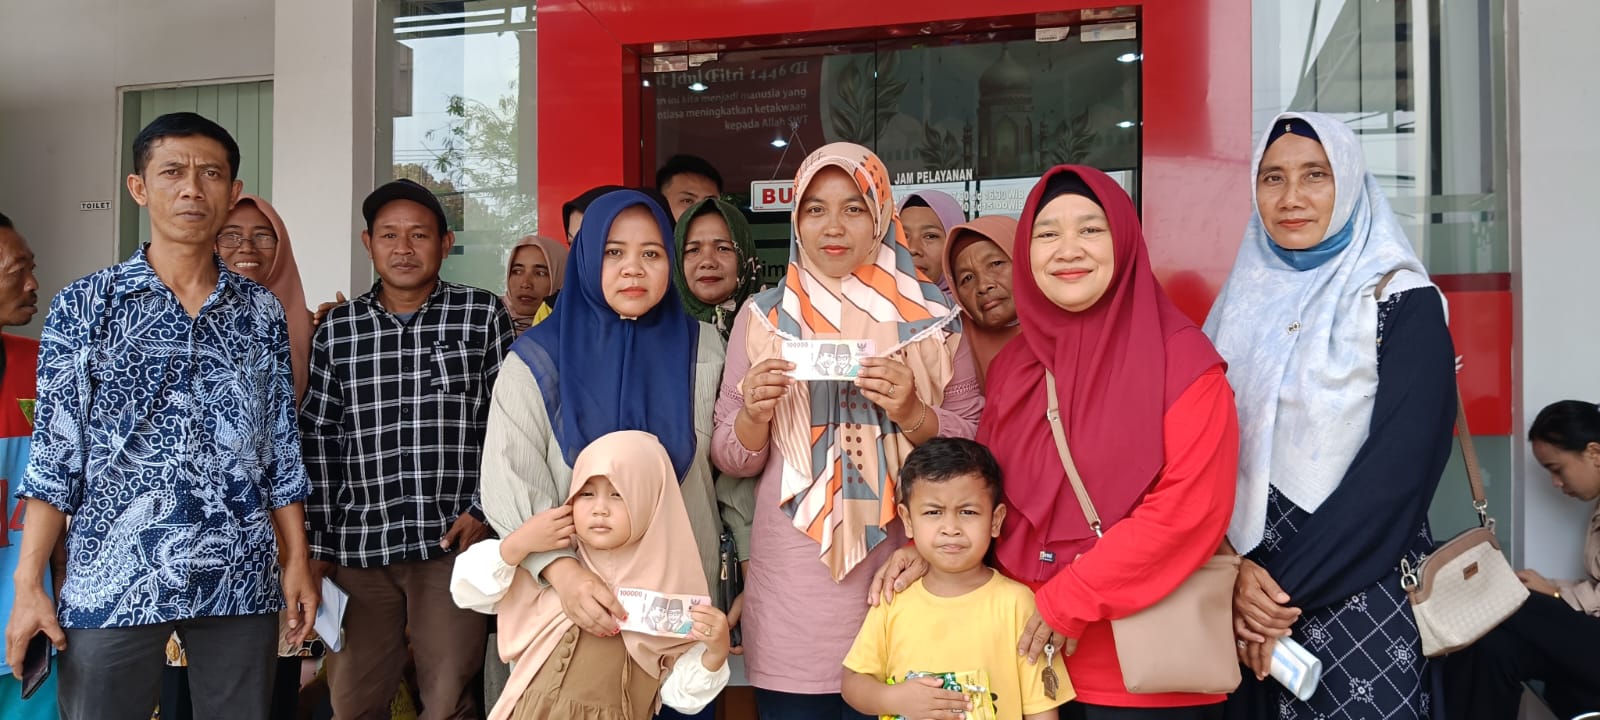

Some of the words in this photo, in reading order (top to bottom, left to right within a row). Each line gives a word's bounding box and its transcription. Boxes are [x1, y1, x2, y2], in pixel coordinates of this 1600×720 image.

[705, 67, 744, 83] Fitri
[752, 65, 786, 81] 1446
[701, 91, 738, 104] menjadi
[740, 88, 780, 101] manusia
[782, 88, 807, 100] yang
[686, 104, 753, 118] meningkatkan
[754, 102, 807, 114] ketakwaan
[724, 118, 760, 131] kepada
[762, 116, 786, 128] Allah
[787, 114, 808, 126] SWT
[894, 172, 914, 185] JAM
[916, 168, 973, 184] PELAYANAN
[762, 188, 793, 205] BU
[1008, 188, 1024, 200] WIB
[1008, 200, 1024, 212] WIB
